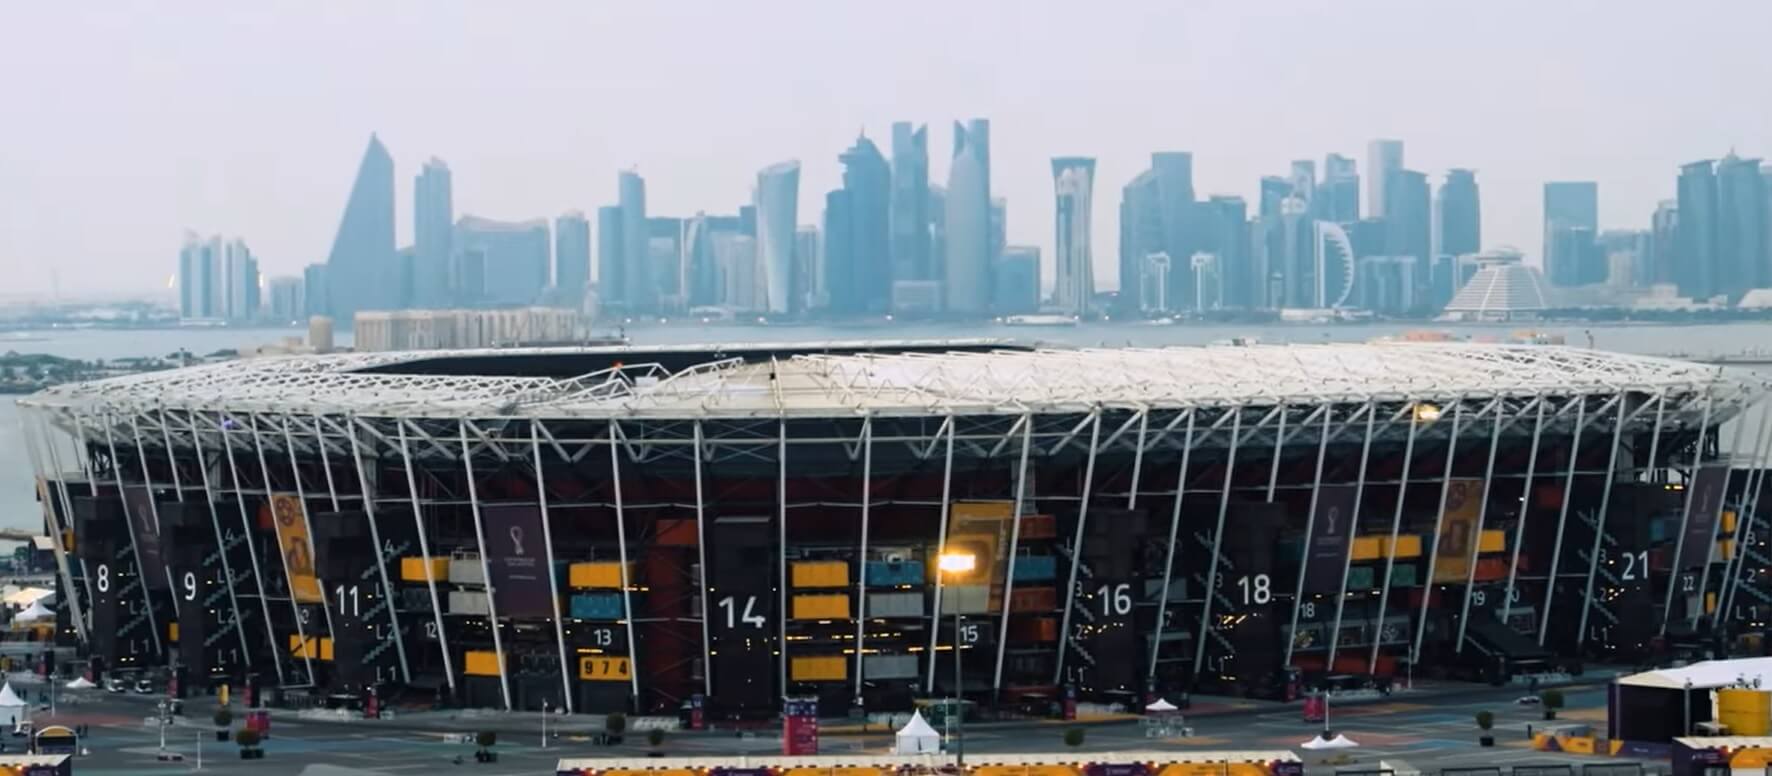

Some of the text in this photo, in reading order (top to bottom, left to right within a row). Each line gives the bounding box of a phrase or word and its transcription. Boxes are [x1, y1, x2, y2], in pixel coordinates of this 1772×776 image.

[97, 564, 109, 592] 8
[1621, 550, 1648, 580] 21
[184, 572, 196, 601] 9
[336, 584, 359, 616] 11
[1097, 583, 1132, 616] 16
[1237, 573, 1271, 605] 18
[718, 595, 766, 629] 14
[1300, 601, 1315, 618] 18
[594, 629, 612, 646] 13
[960, 625, 978, 642] 15
